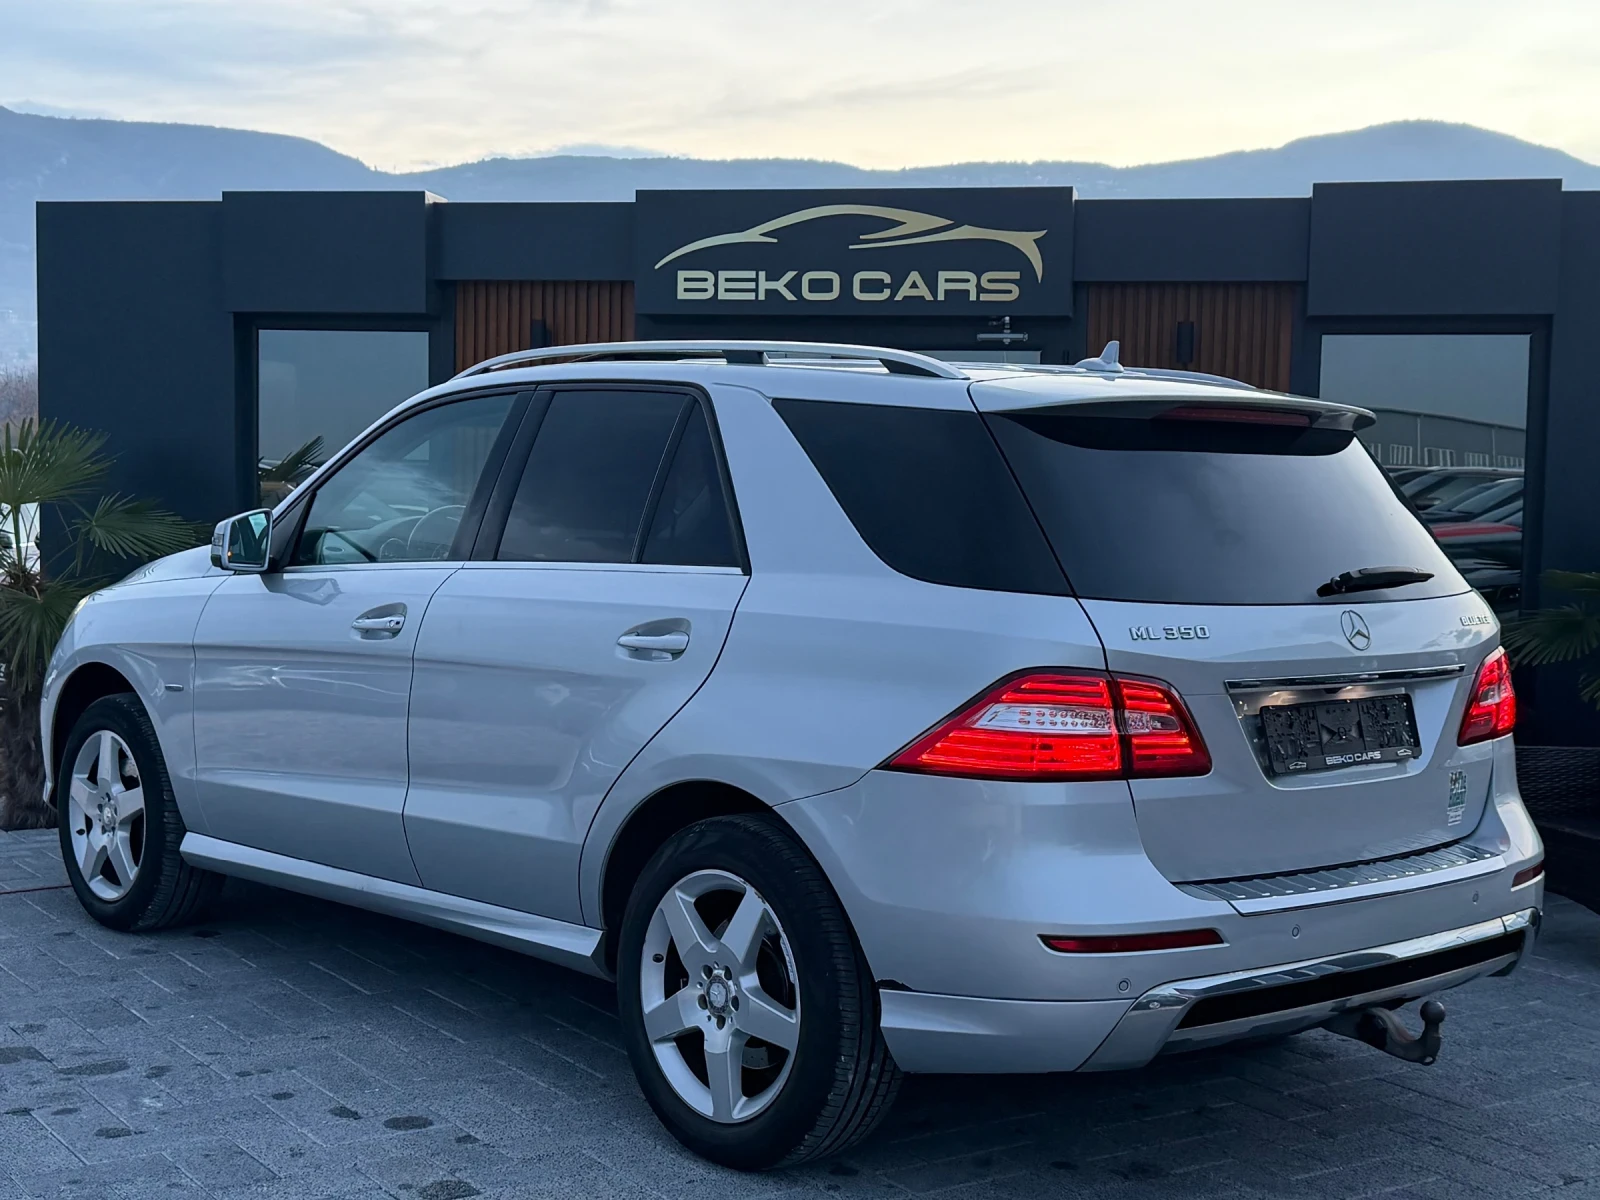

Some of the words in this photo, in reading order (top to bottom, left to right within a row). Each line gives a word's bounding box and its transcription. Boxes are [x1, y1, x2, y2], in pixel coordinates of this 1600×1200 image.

[677, 270, 841, 301] BEKO
[852, 270, 1021, 301] CARS
[1129, 626, 1161, 641] ML
[1163, 625, 1210, 640] 350
[1326, 754, 1353, 765] BEKO
[1355, 751, 1382, 763] CARS
